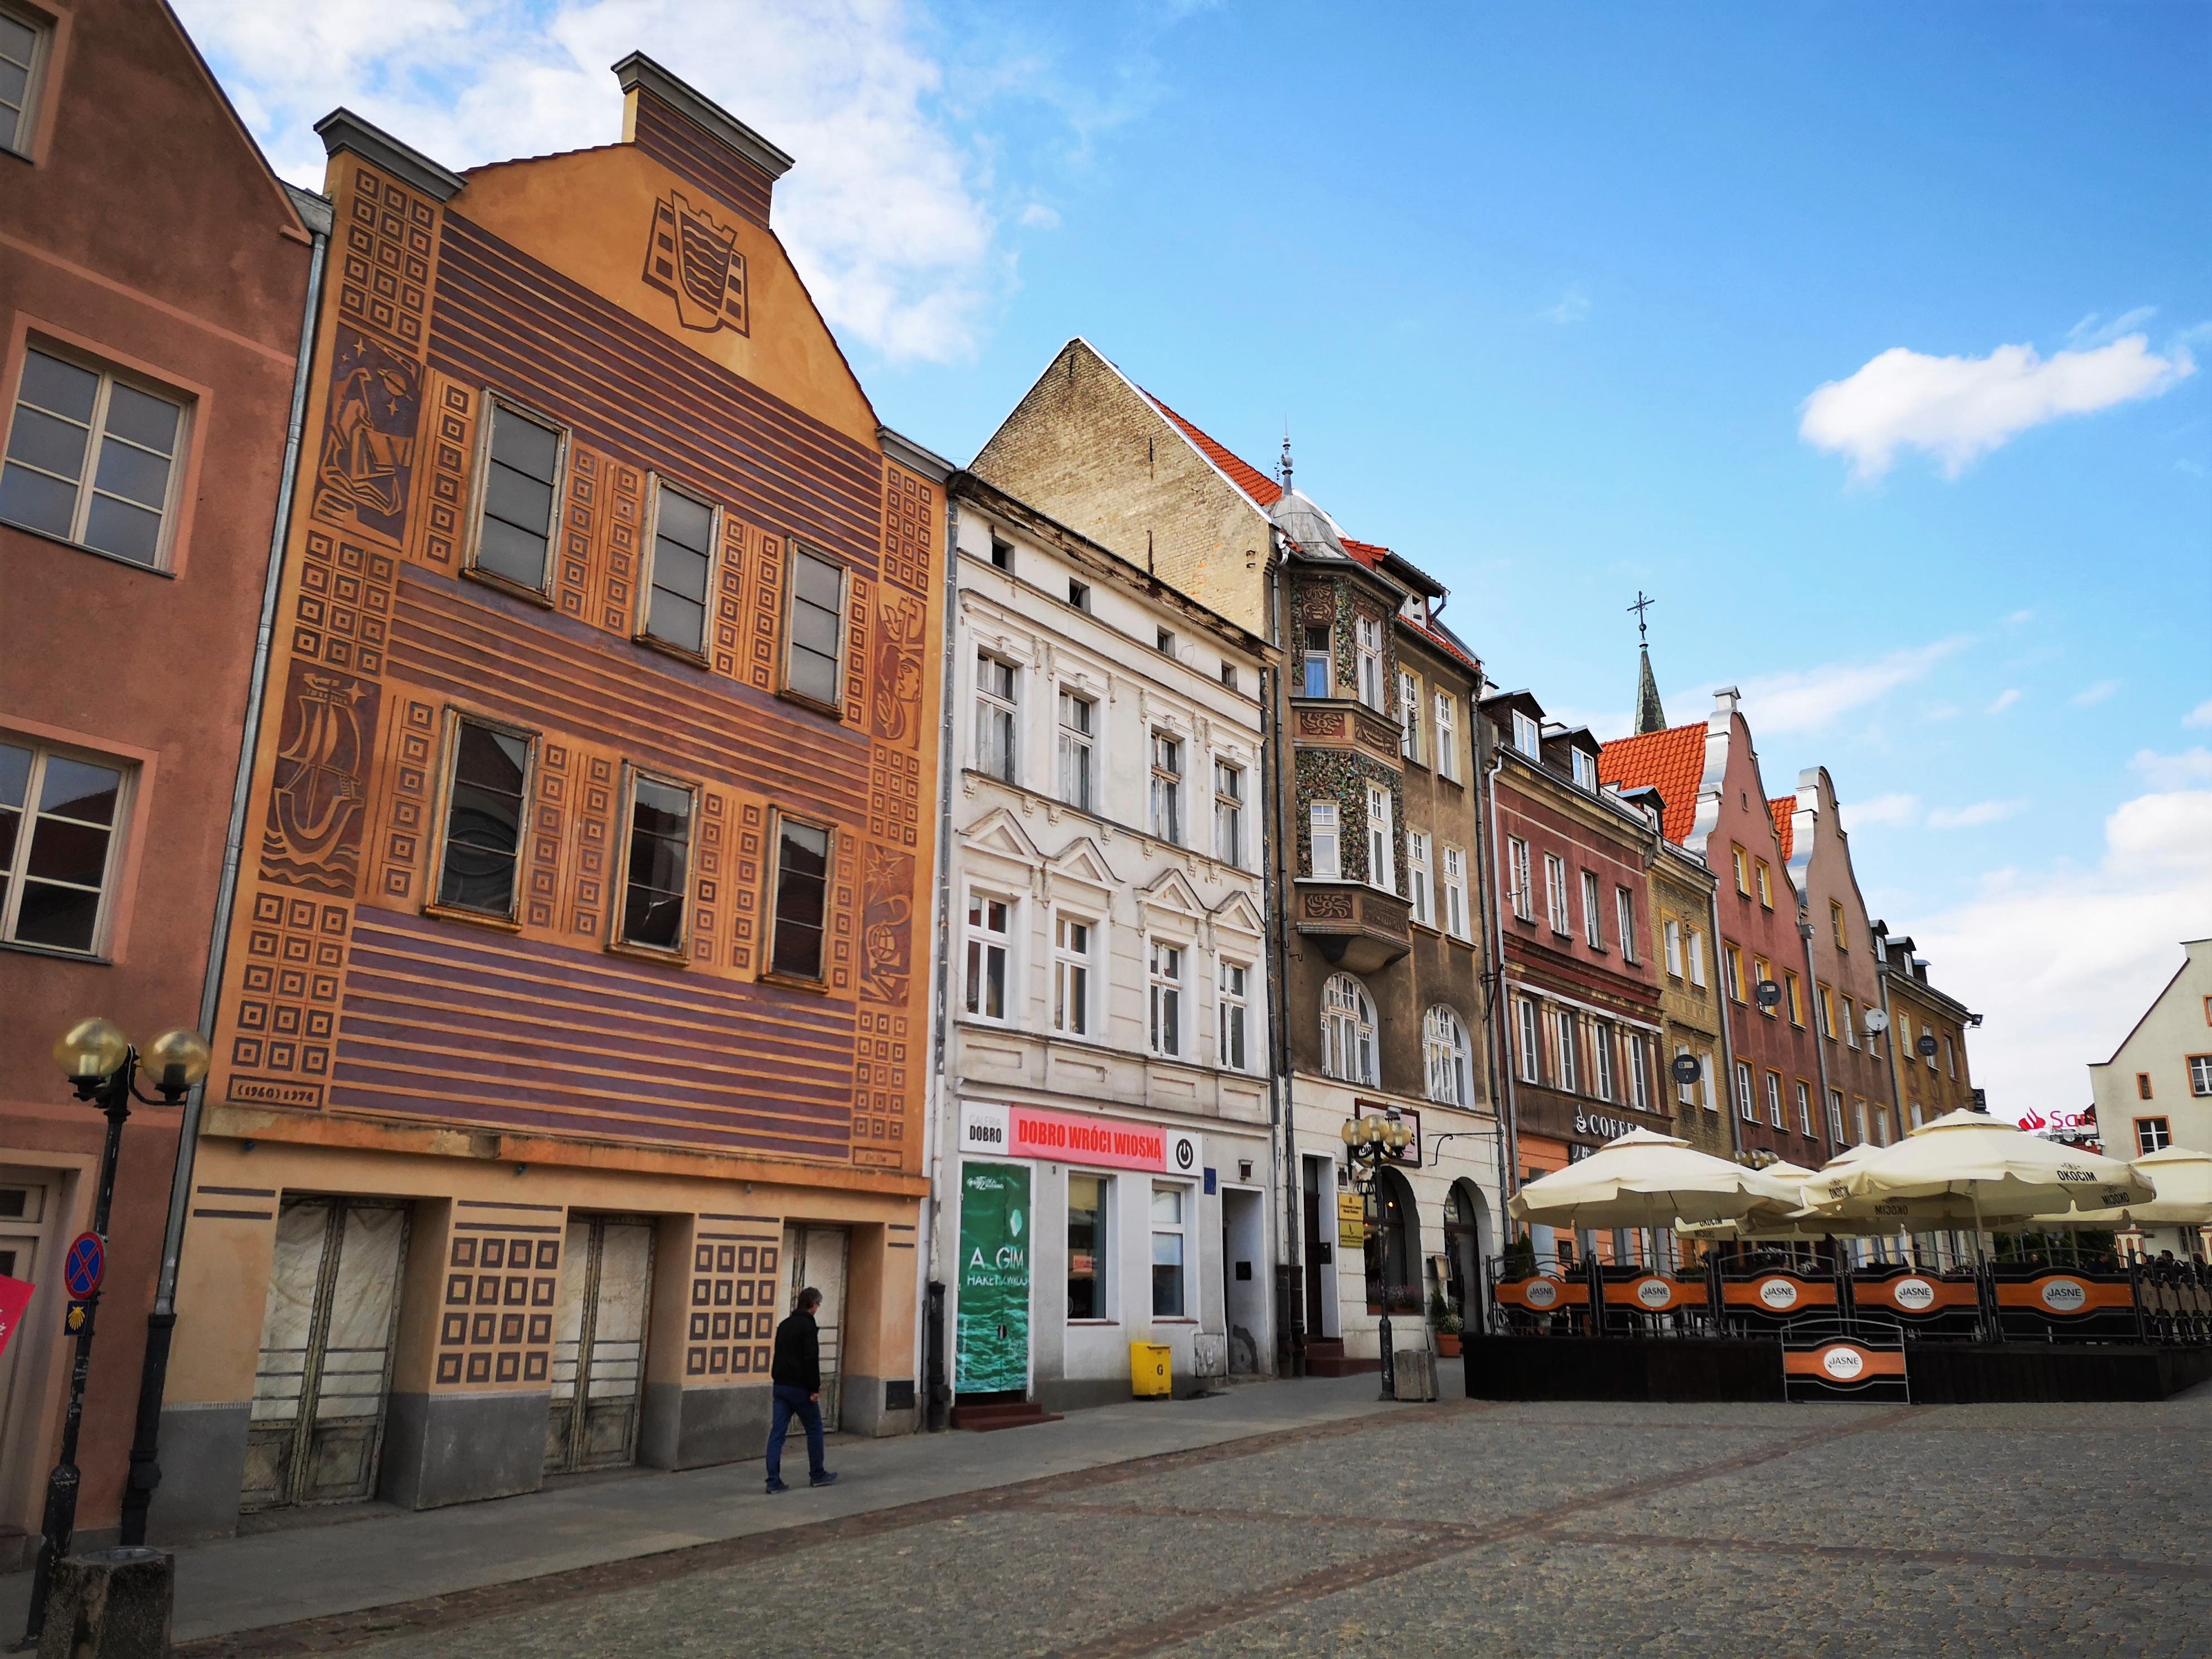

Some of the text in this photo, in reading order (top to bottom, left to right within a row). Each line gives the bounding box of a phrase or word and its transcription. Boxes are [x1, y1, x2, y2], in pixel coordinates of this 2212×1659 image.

[969, 1125, 1002, 1143] DOBRO
[1018, 1119, 1162, 1163] DOBRO WRÓCI WIOSNĄ
[2056, 1170, 2098, 1182] OKOCIM
[1641, 1287, 1668, 1295] JASNE
[1899, 1287, 1930, 1296] JASNE
[2046, 1288, 2082, 1297] JASNE
[1828, 1356, 1859, 1365] JASNE
[1157, 1364, 1163, 1376] G
